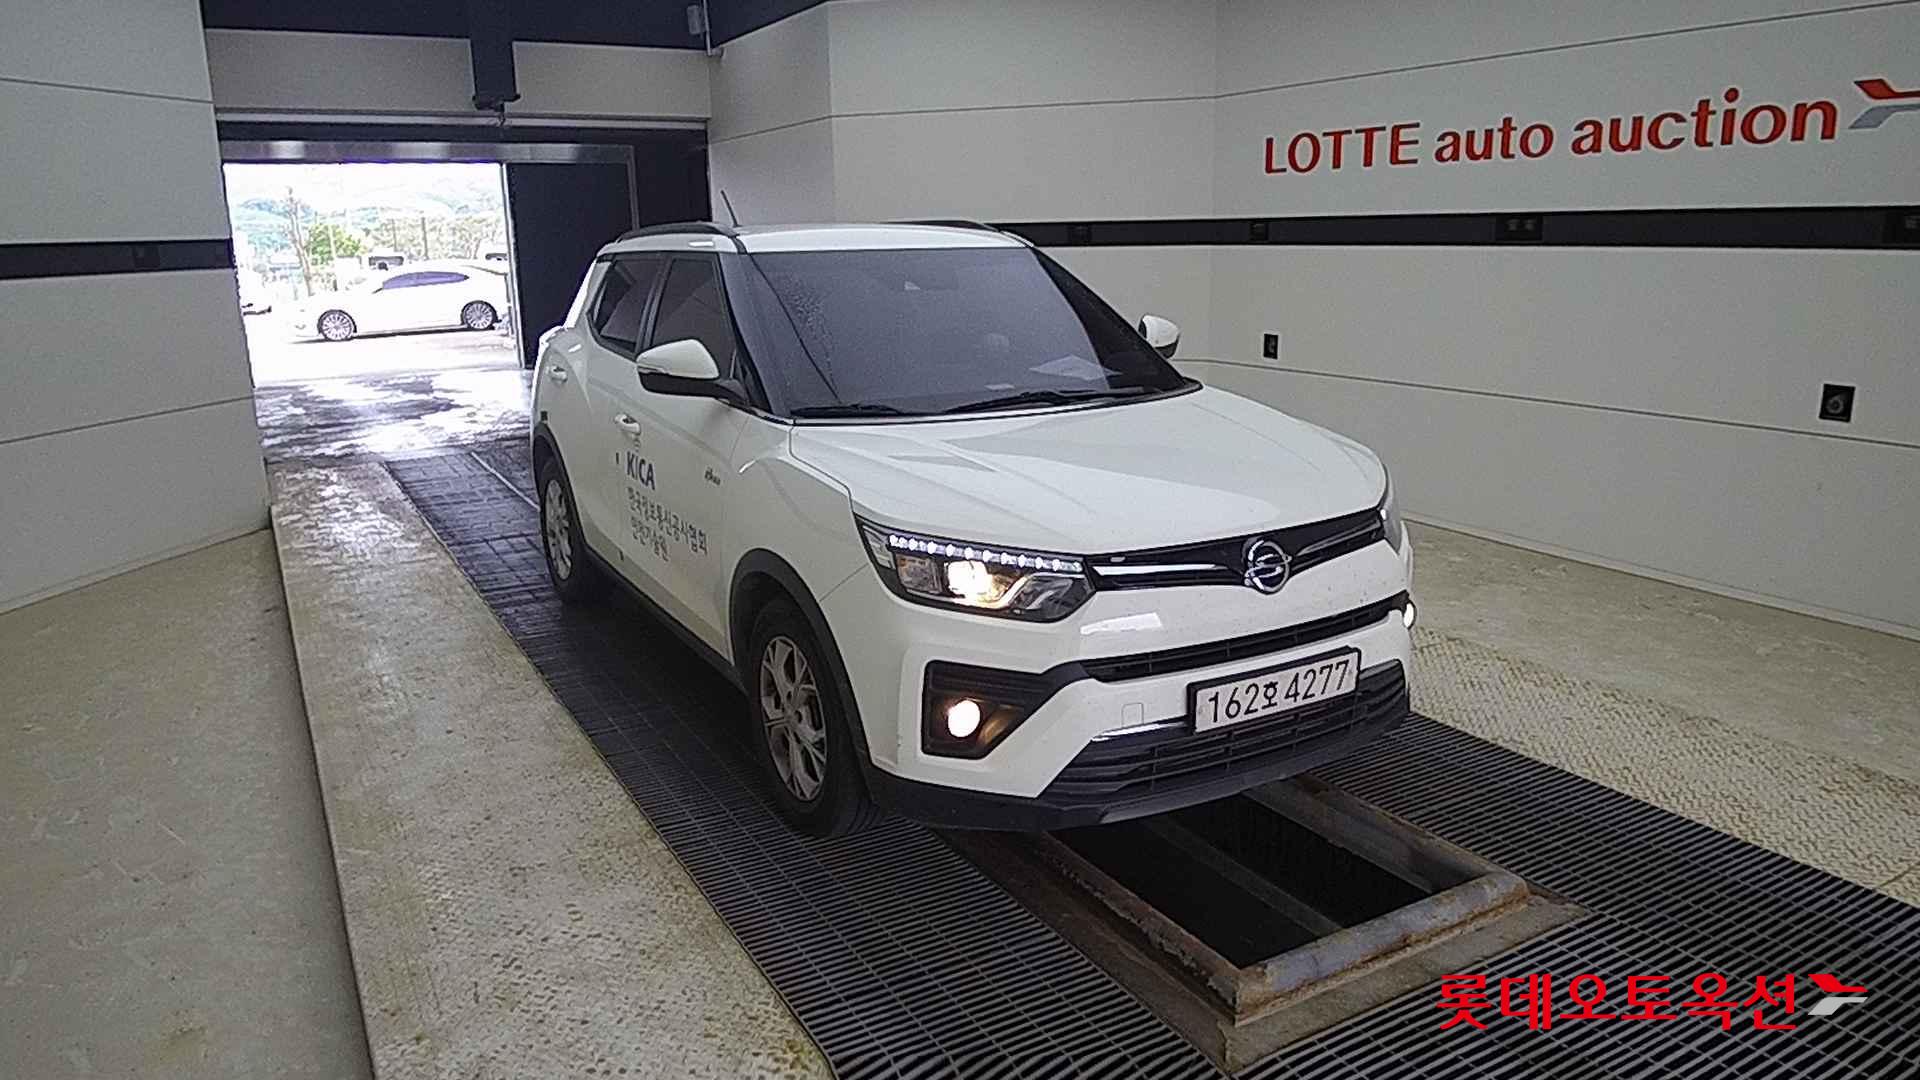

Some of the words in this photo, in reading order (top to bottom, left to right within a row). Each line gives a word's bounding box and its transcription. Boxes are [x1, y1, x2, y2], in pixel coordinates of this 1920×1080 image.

[1265, 122, 1421, 175] LOTTE
[1434, 118, 1554, 163] auto
[1571, 87, 1838, 155] auction
[626, 451, 655, 490] KICA
[1284, 659, 1350, 703] 4277
